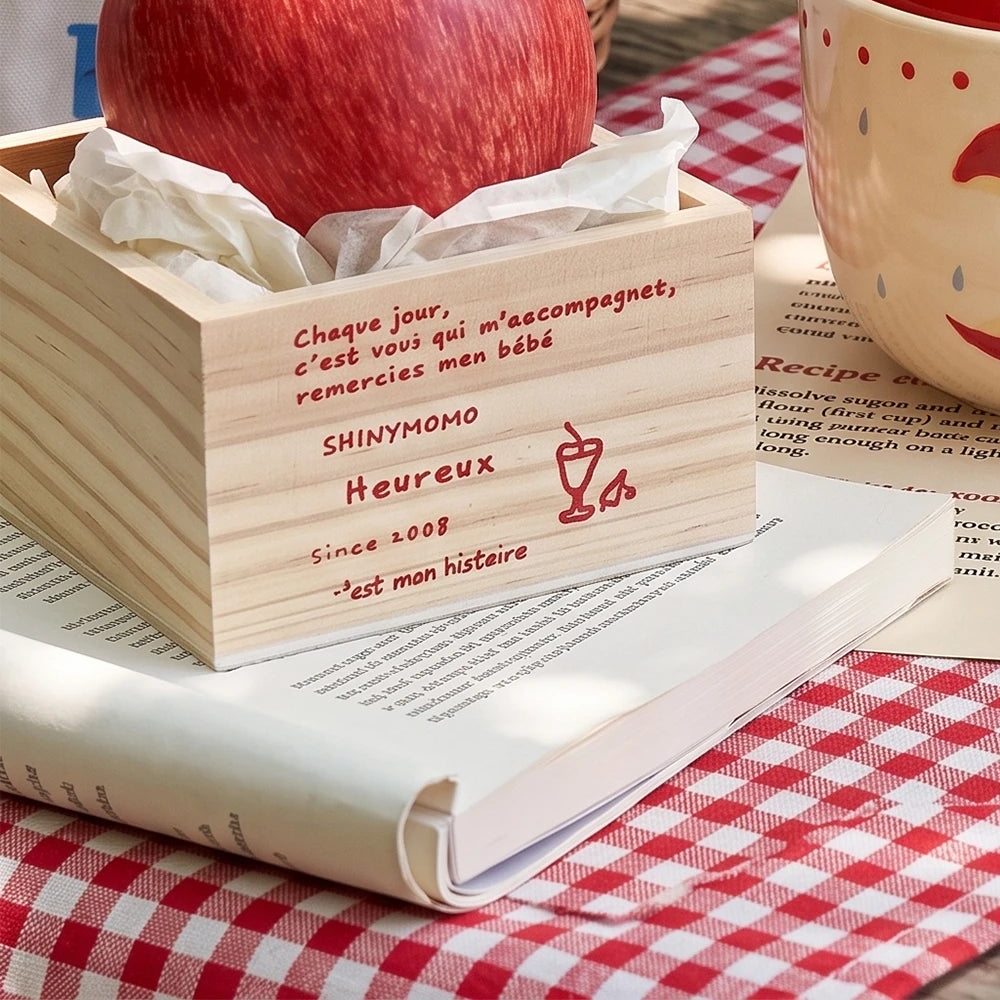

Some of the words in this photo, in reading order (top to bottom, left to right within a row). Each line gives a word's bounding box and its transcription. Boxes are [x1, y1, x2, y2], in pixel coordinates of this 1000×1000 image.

[294, 318, 382, 349] Chaque
[390, 304, 450, 335] jour,
[294, 346, 359, 376] c'est
[432, 320, 466, 351] qui
[296, 363, 425, 405] remercies
[498, 328, 553, 359] bébé
[755, 355, 881, 383] Recipe
[323, 406, 479, 456] SHINYMOMO
[758, 400, 815, 413] flour
[821, 406, 876, 420] (first
[881, 414, 932, 426] cup)
[939, 419, 985, 430] and
[915, 402, 963, 415] and
[756, 441, 810, 458] long.
[760, 428, 809, 444] long
[815, 435, 899, 451] enough
[906, 443, 934, 453] on
[941, 446, 953, 455] a
[346, 454, 495, 504] Heureux
[311, 538, 378, 564] Since
[391, 516, 449, 544] 2008
